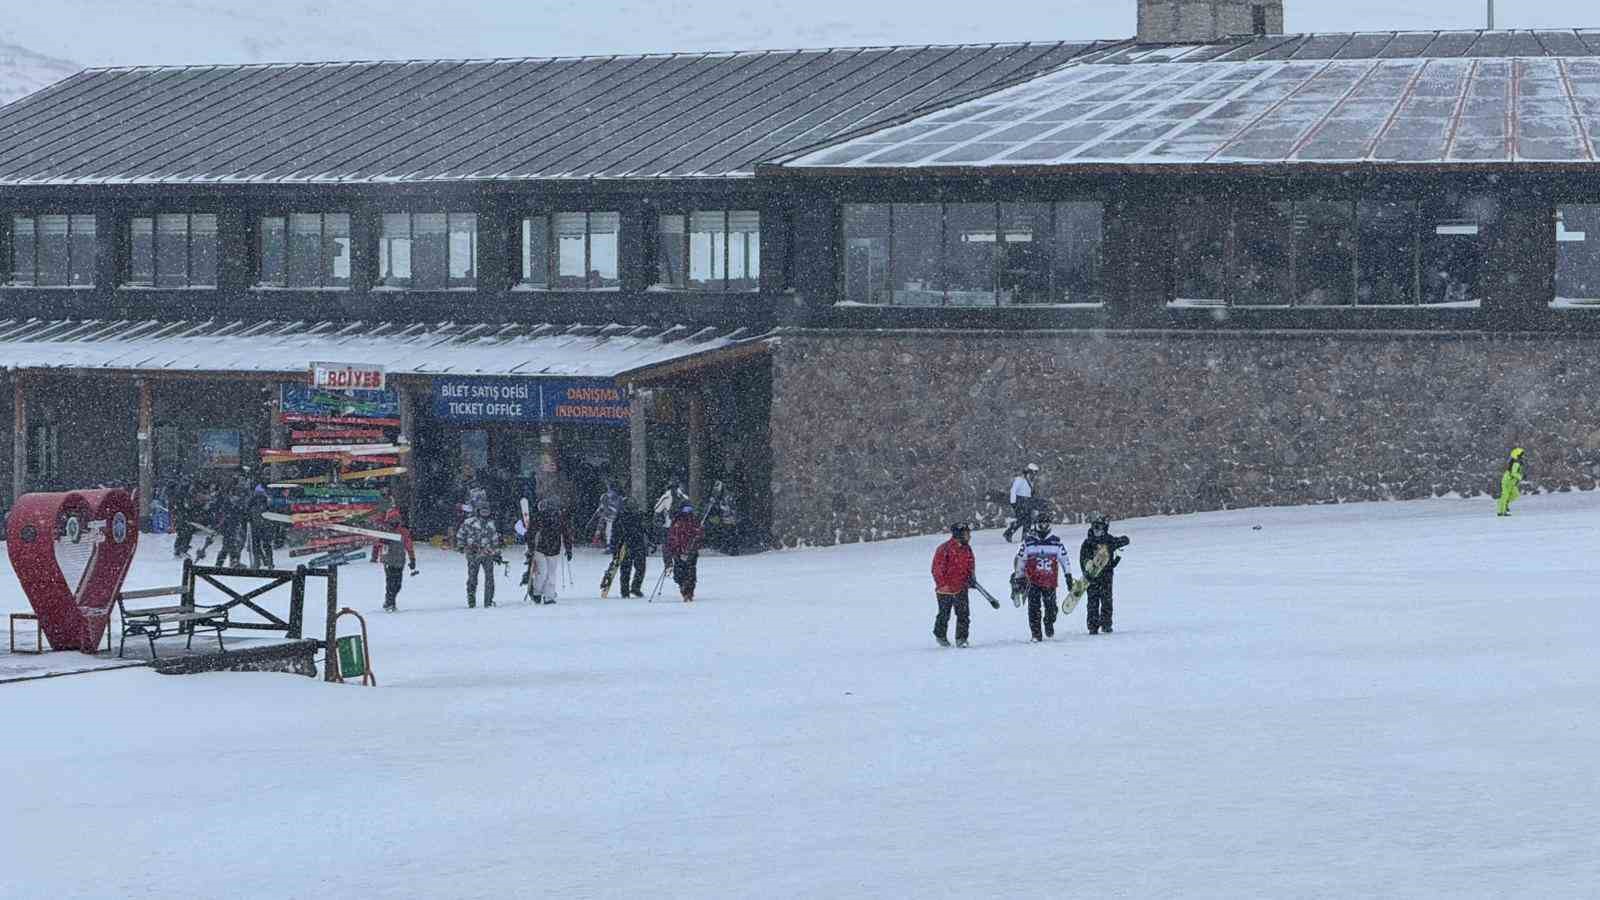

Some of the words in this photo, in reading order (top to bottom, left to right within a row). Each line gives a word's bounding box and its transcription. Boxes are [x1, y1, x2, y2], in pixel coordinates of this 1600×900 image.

[441, 383, 469, 398] BİLET
[471, 386, 499, 400] SATIŞ
[501, 384, 529, 399] OFİSİ
[449, 402, 484, 415] TICKET
[486, 402, 522, 416] OFFICE
[555, 404, 633, 418] INFORMATION
